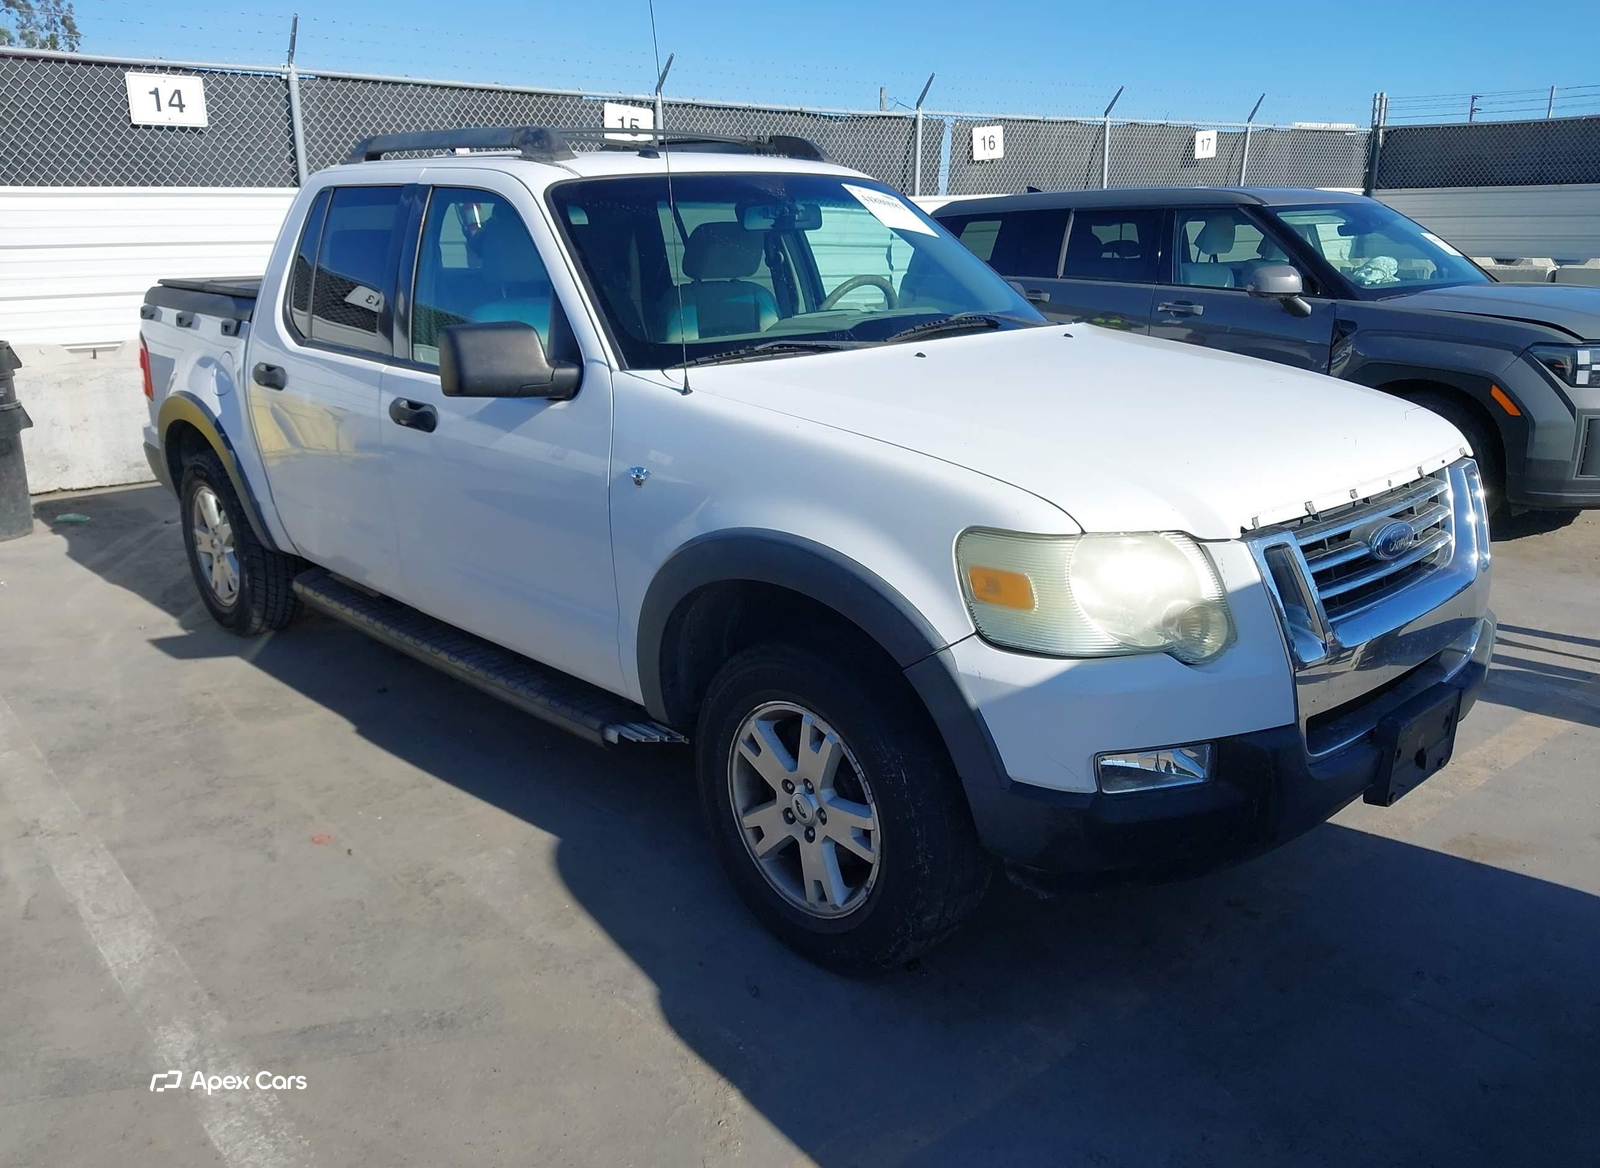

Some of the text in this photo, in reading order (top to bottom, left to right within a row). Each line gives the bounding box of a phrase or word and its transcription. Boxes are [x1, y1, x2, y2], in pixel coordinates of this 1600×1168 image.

[148, 87, 186, 113] 14
[617, 115, 640, 137] 15
[980, 134, 996, 151] 16
[1200, 137, 1211, 151] 17
